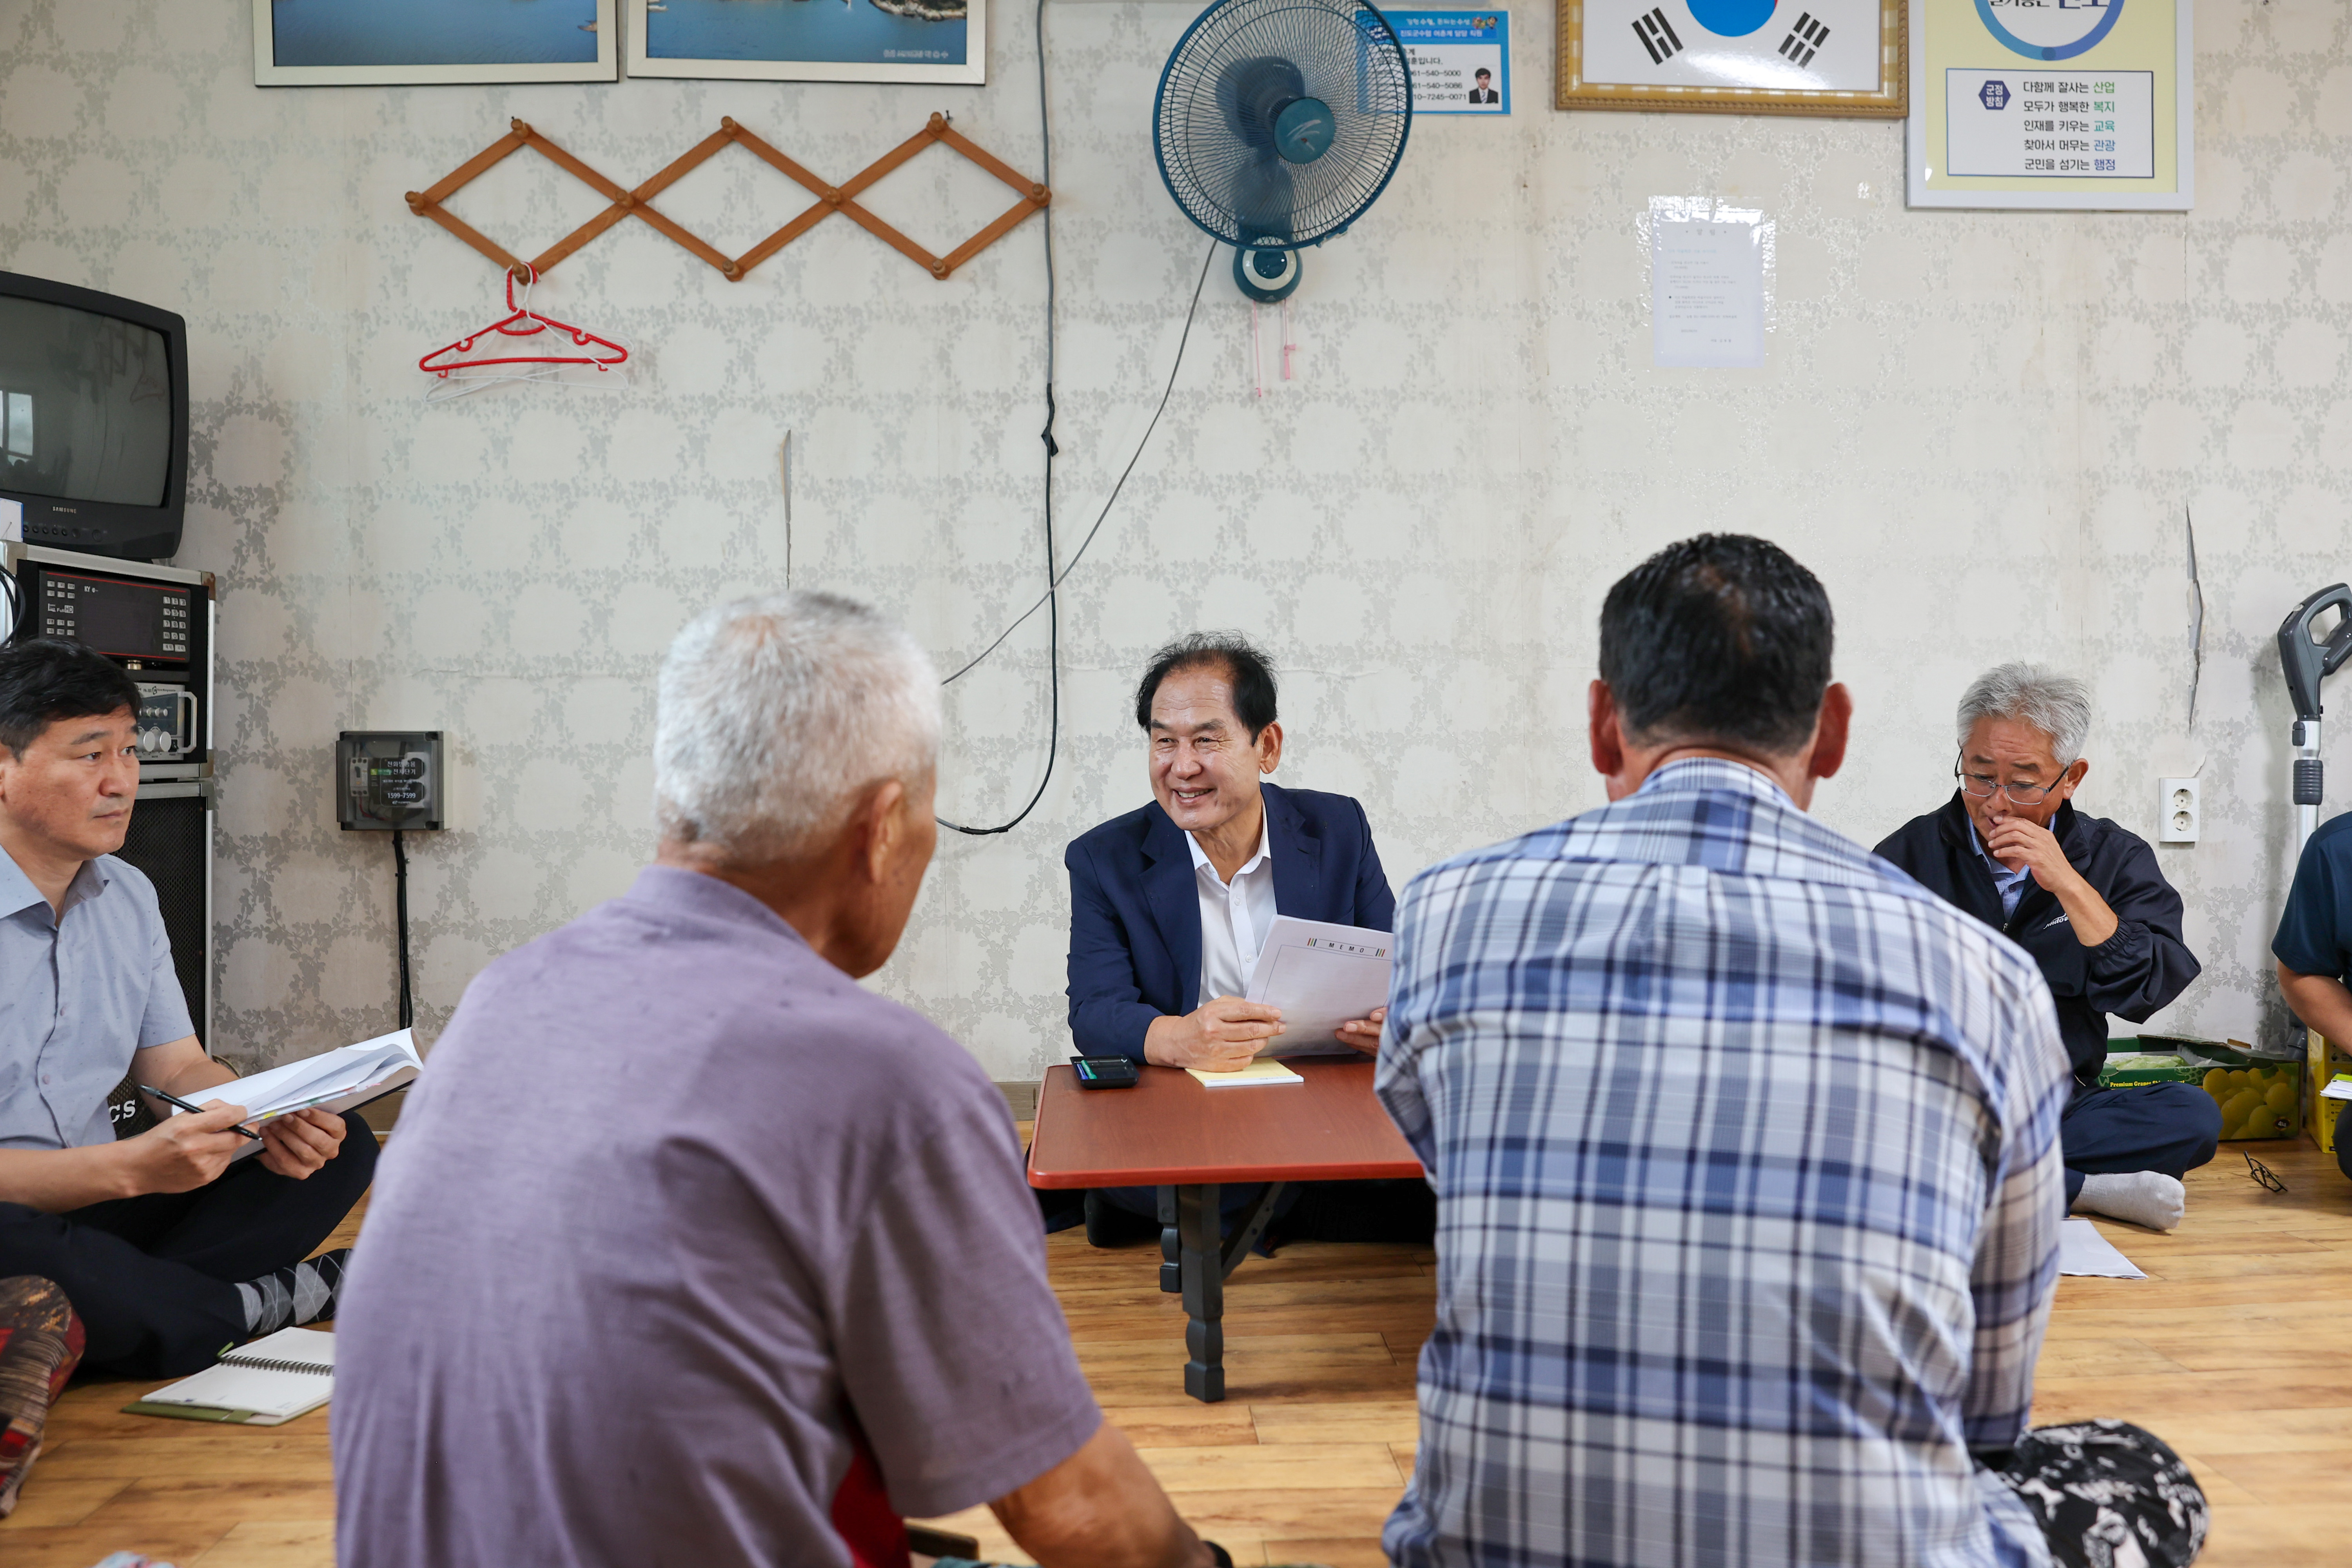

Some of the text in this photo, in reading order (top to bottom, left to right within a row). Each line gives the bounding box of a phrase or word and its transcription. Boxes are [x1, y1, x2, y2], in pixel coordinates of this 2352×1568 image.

[1400, 29, 1432, 38] 진도군수협
[1985, 84, 2004, 96] 군정
[2023, 82, 2115, 94] 다함께 잘사는 산업
[1985, 96, 2004, 107] 방침
[2024, 101, 2115, 113] 모두가 행복한 복지
[2024, 120, 2115, 132] 인재를 키우는 교육
[2024, 139, 2116, 152] 찾아서 머무는 관광
[2024, 158, 2116, 171] 군민을 섬기는 행정
